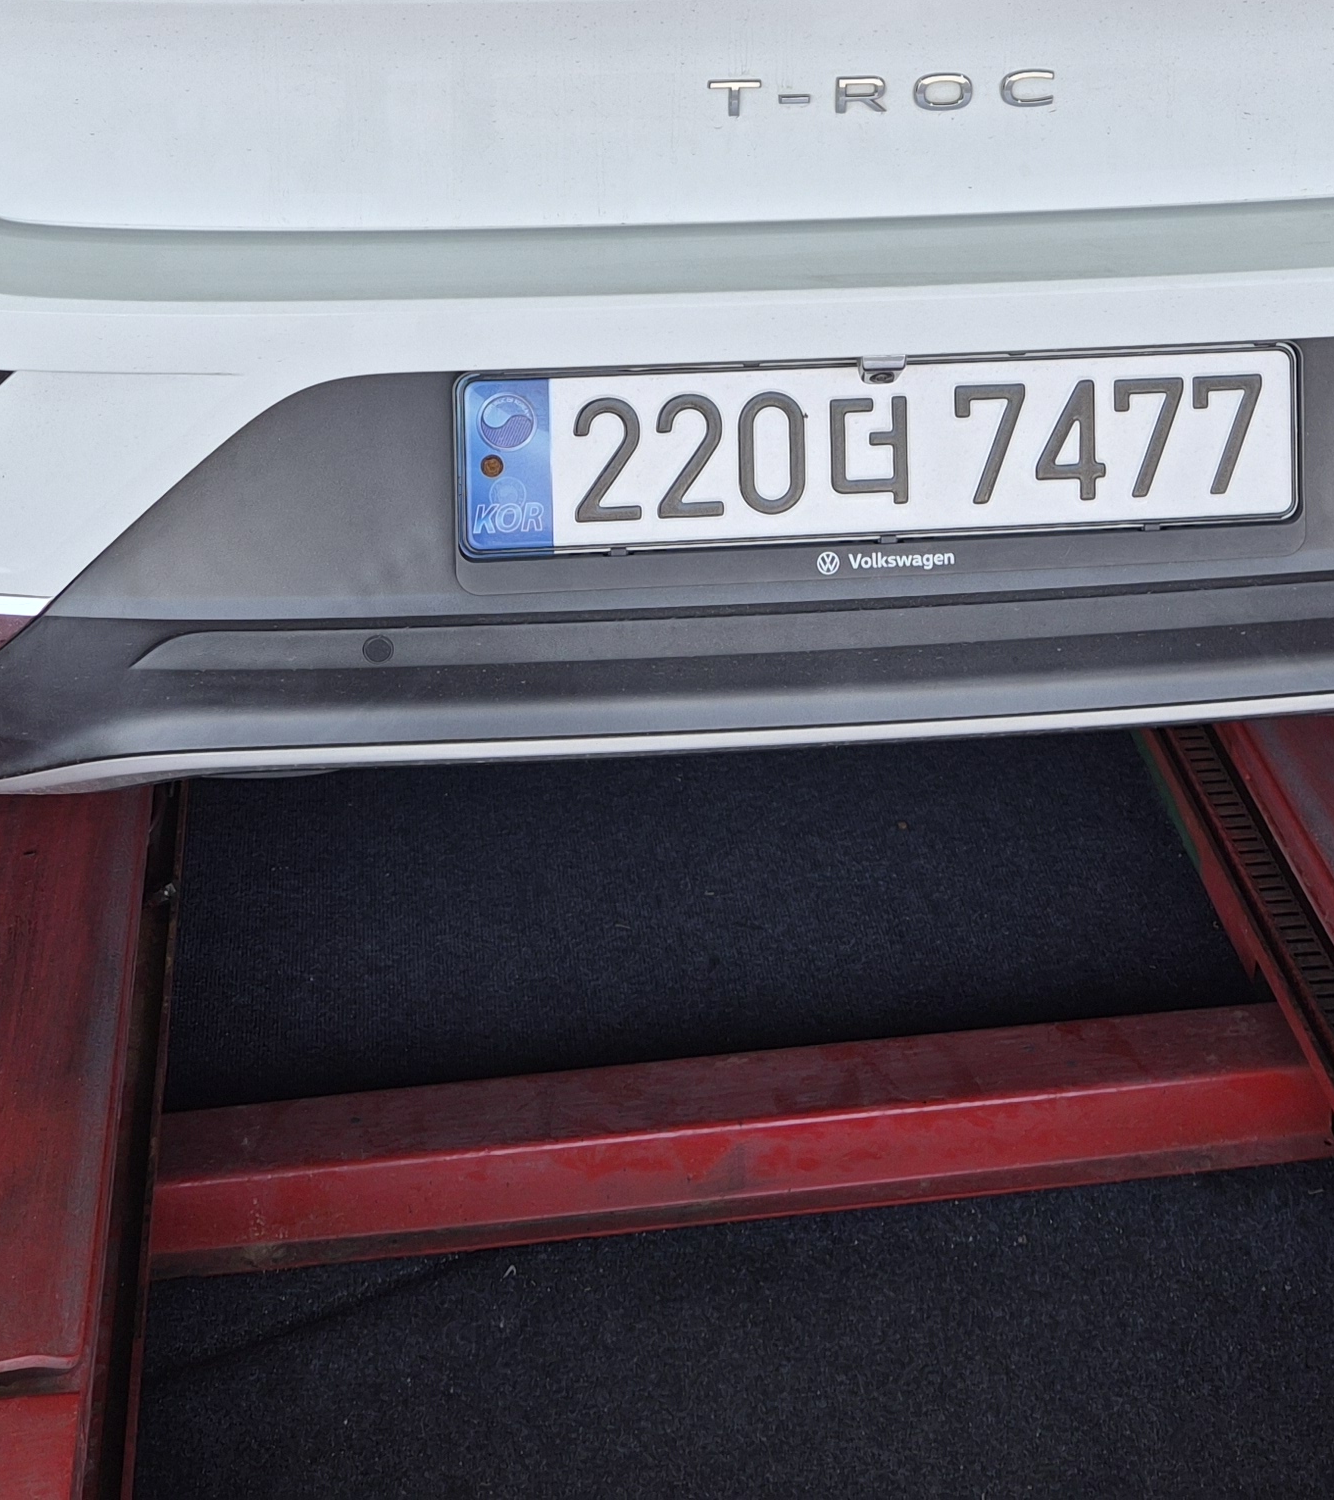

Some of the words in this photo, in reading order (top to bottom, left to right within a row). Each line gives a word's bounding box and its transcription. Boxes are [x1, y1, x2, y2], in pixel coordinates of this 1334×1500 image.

[706, 67, 1056, 118] T-ROC
[572, 389, 910, 524] 220더
[952, 373, 1264, 506] 7477
[472, 501, 545, 535] KOR
[847, 547, 956, 572] Volkswagen
